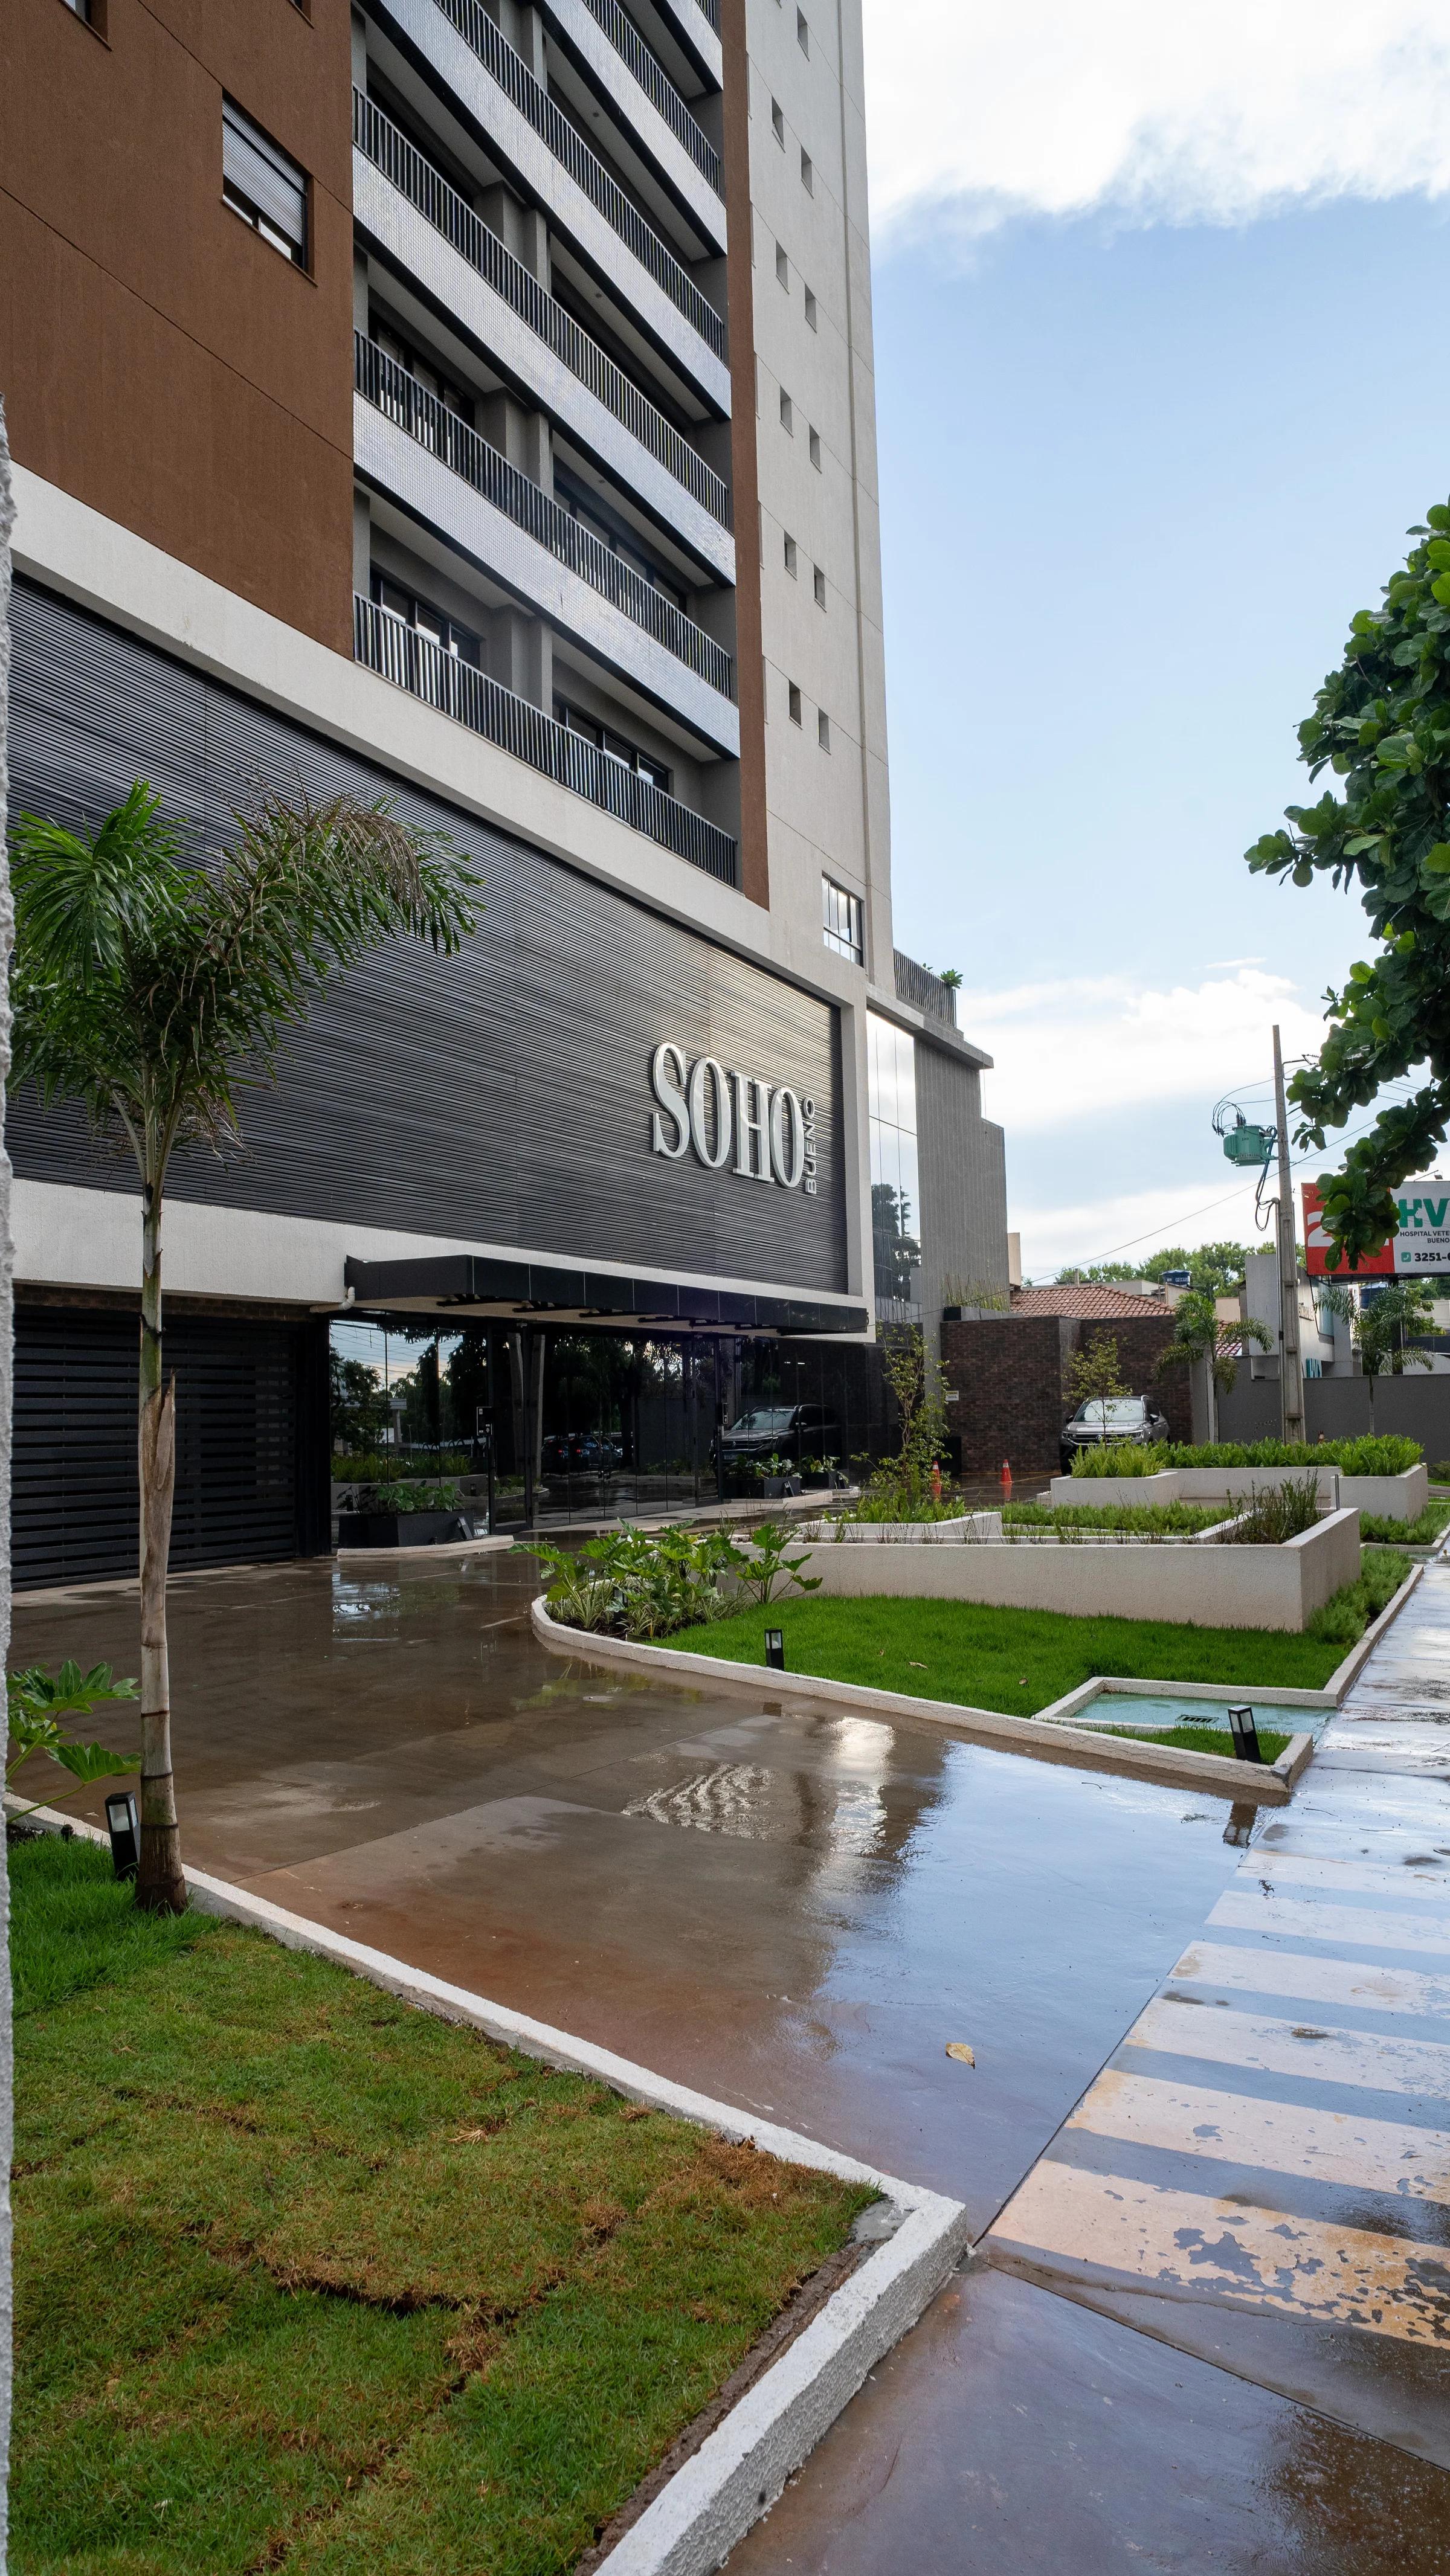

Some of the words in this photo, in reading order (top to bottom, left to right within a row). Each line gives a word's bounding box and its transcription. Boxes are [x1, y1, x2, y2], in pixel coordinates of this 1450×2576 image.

[653, 1042, 805, 1188] SOHO
[803, 1097, 817, 1195] BUENO
[1398, 1198, 1450, 1228] HV
